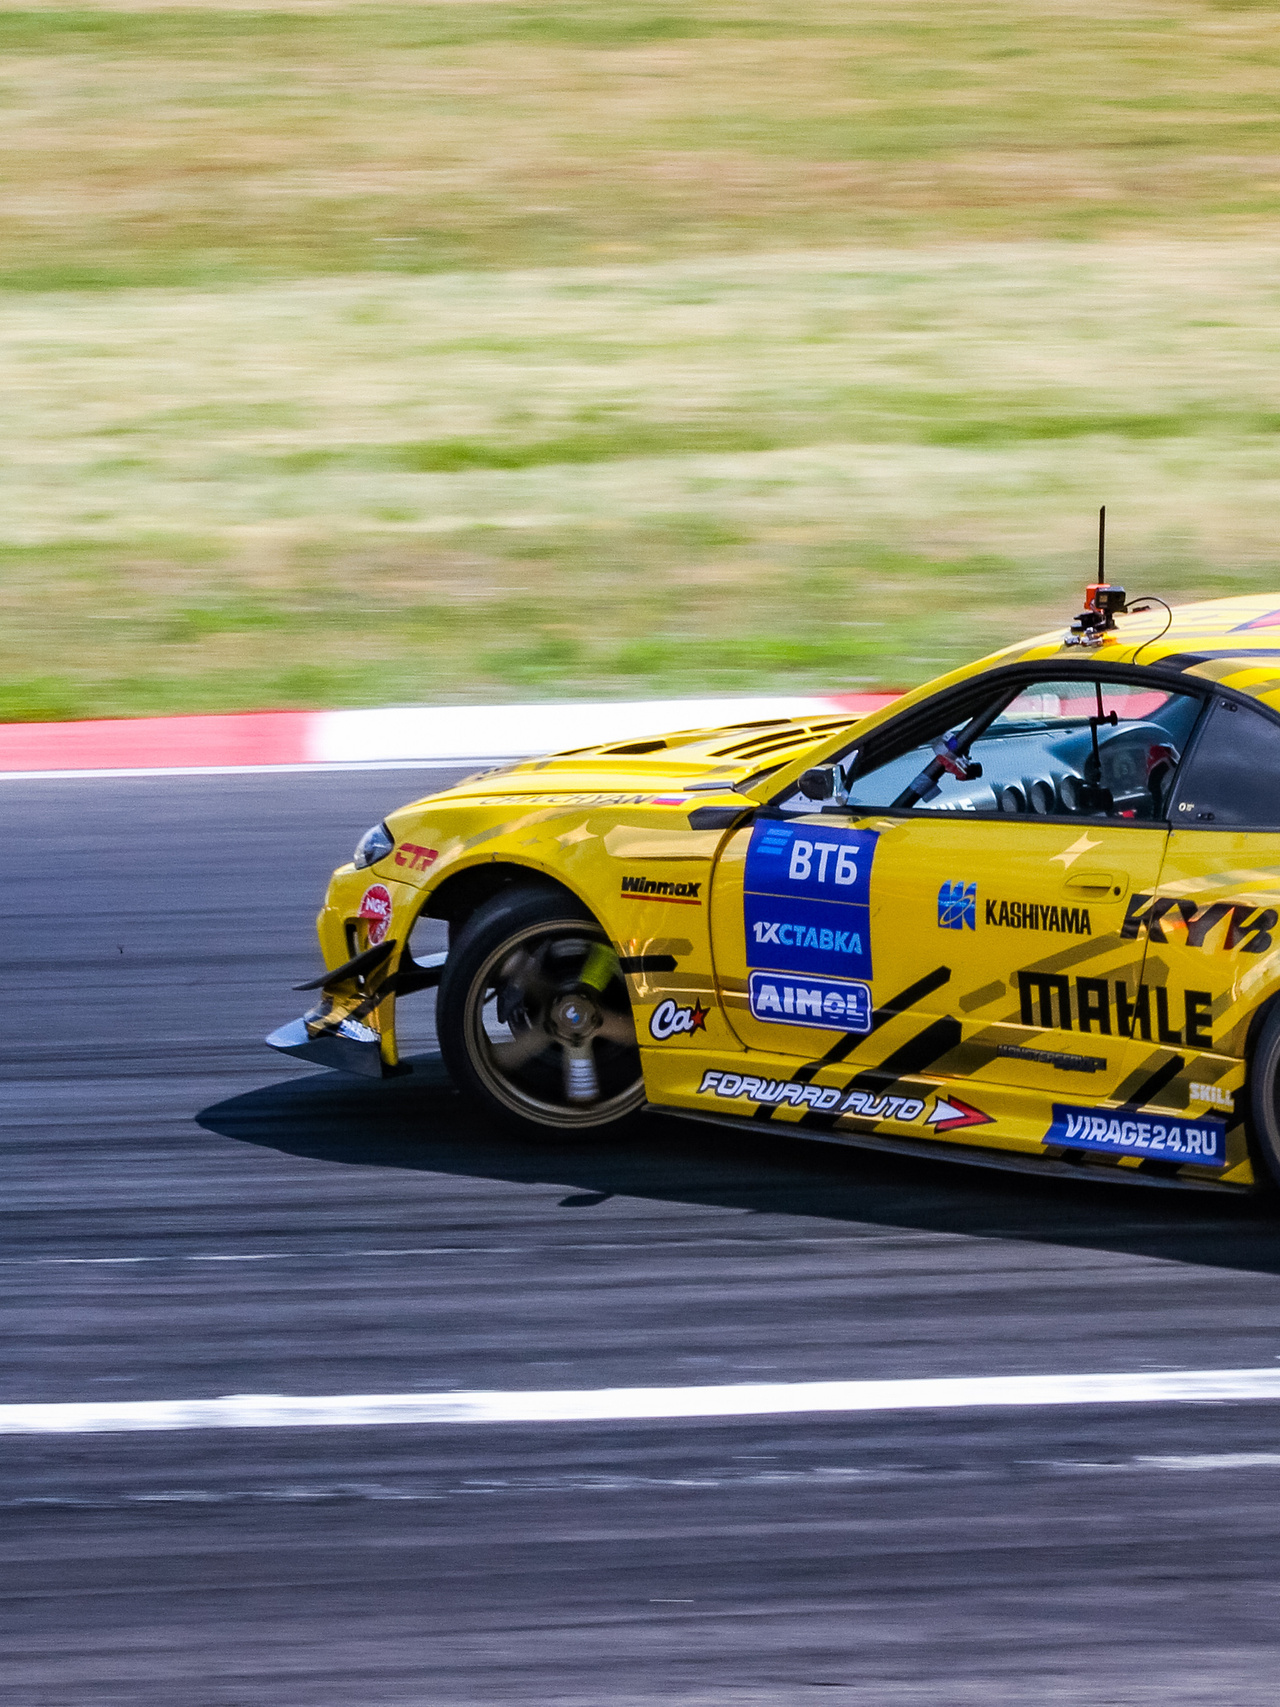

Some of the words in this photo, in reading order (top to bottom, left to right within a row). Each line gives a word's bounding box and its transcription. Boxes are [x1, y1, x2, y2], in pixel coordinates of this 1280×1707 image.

[788, 839, 860, 886] ВТБ
[366, 897, 389, 915] NGK
[985, 899, 1092, 935] KASHIYAMA
[1119, 893, 1279, 954] KYB
[756, 984, 865, 1022] AIMOL
[1017, 970, 1213, 1048] MAHLE
[700, 1071, 842, 1109] FORWARD
[839, 1094, 926, 1121] AUTO
[1189, 1082, 1235, 1107] SKILL
[1065, 1113, 1218, 1156] VIRAGE24.RU
